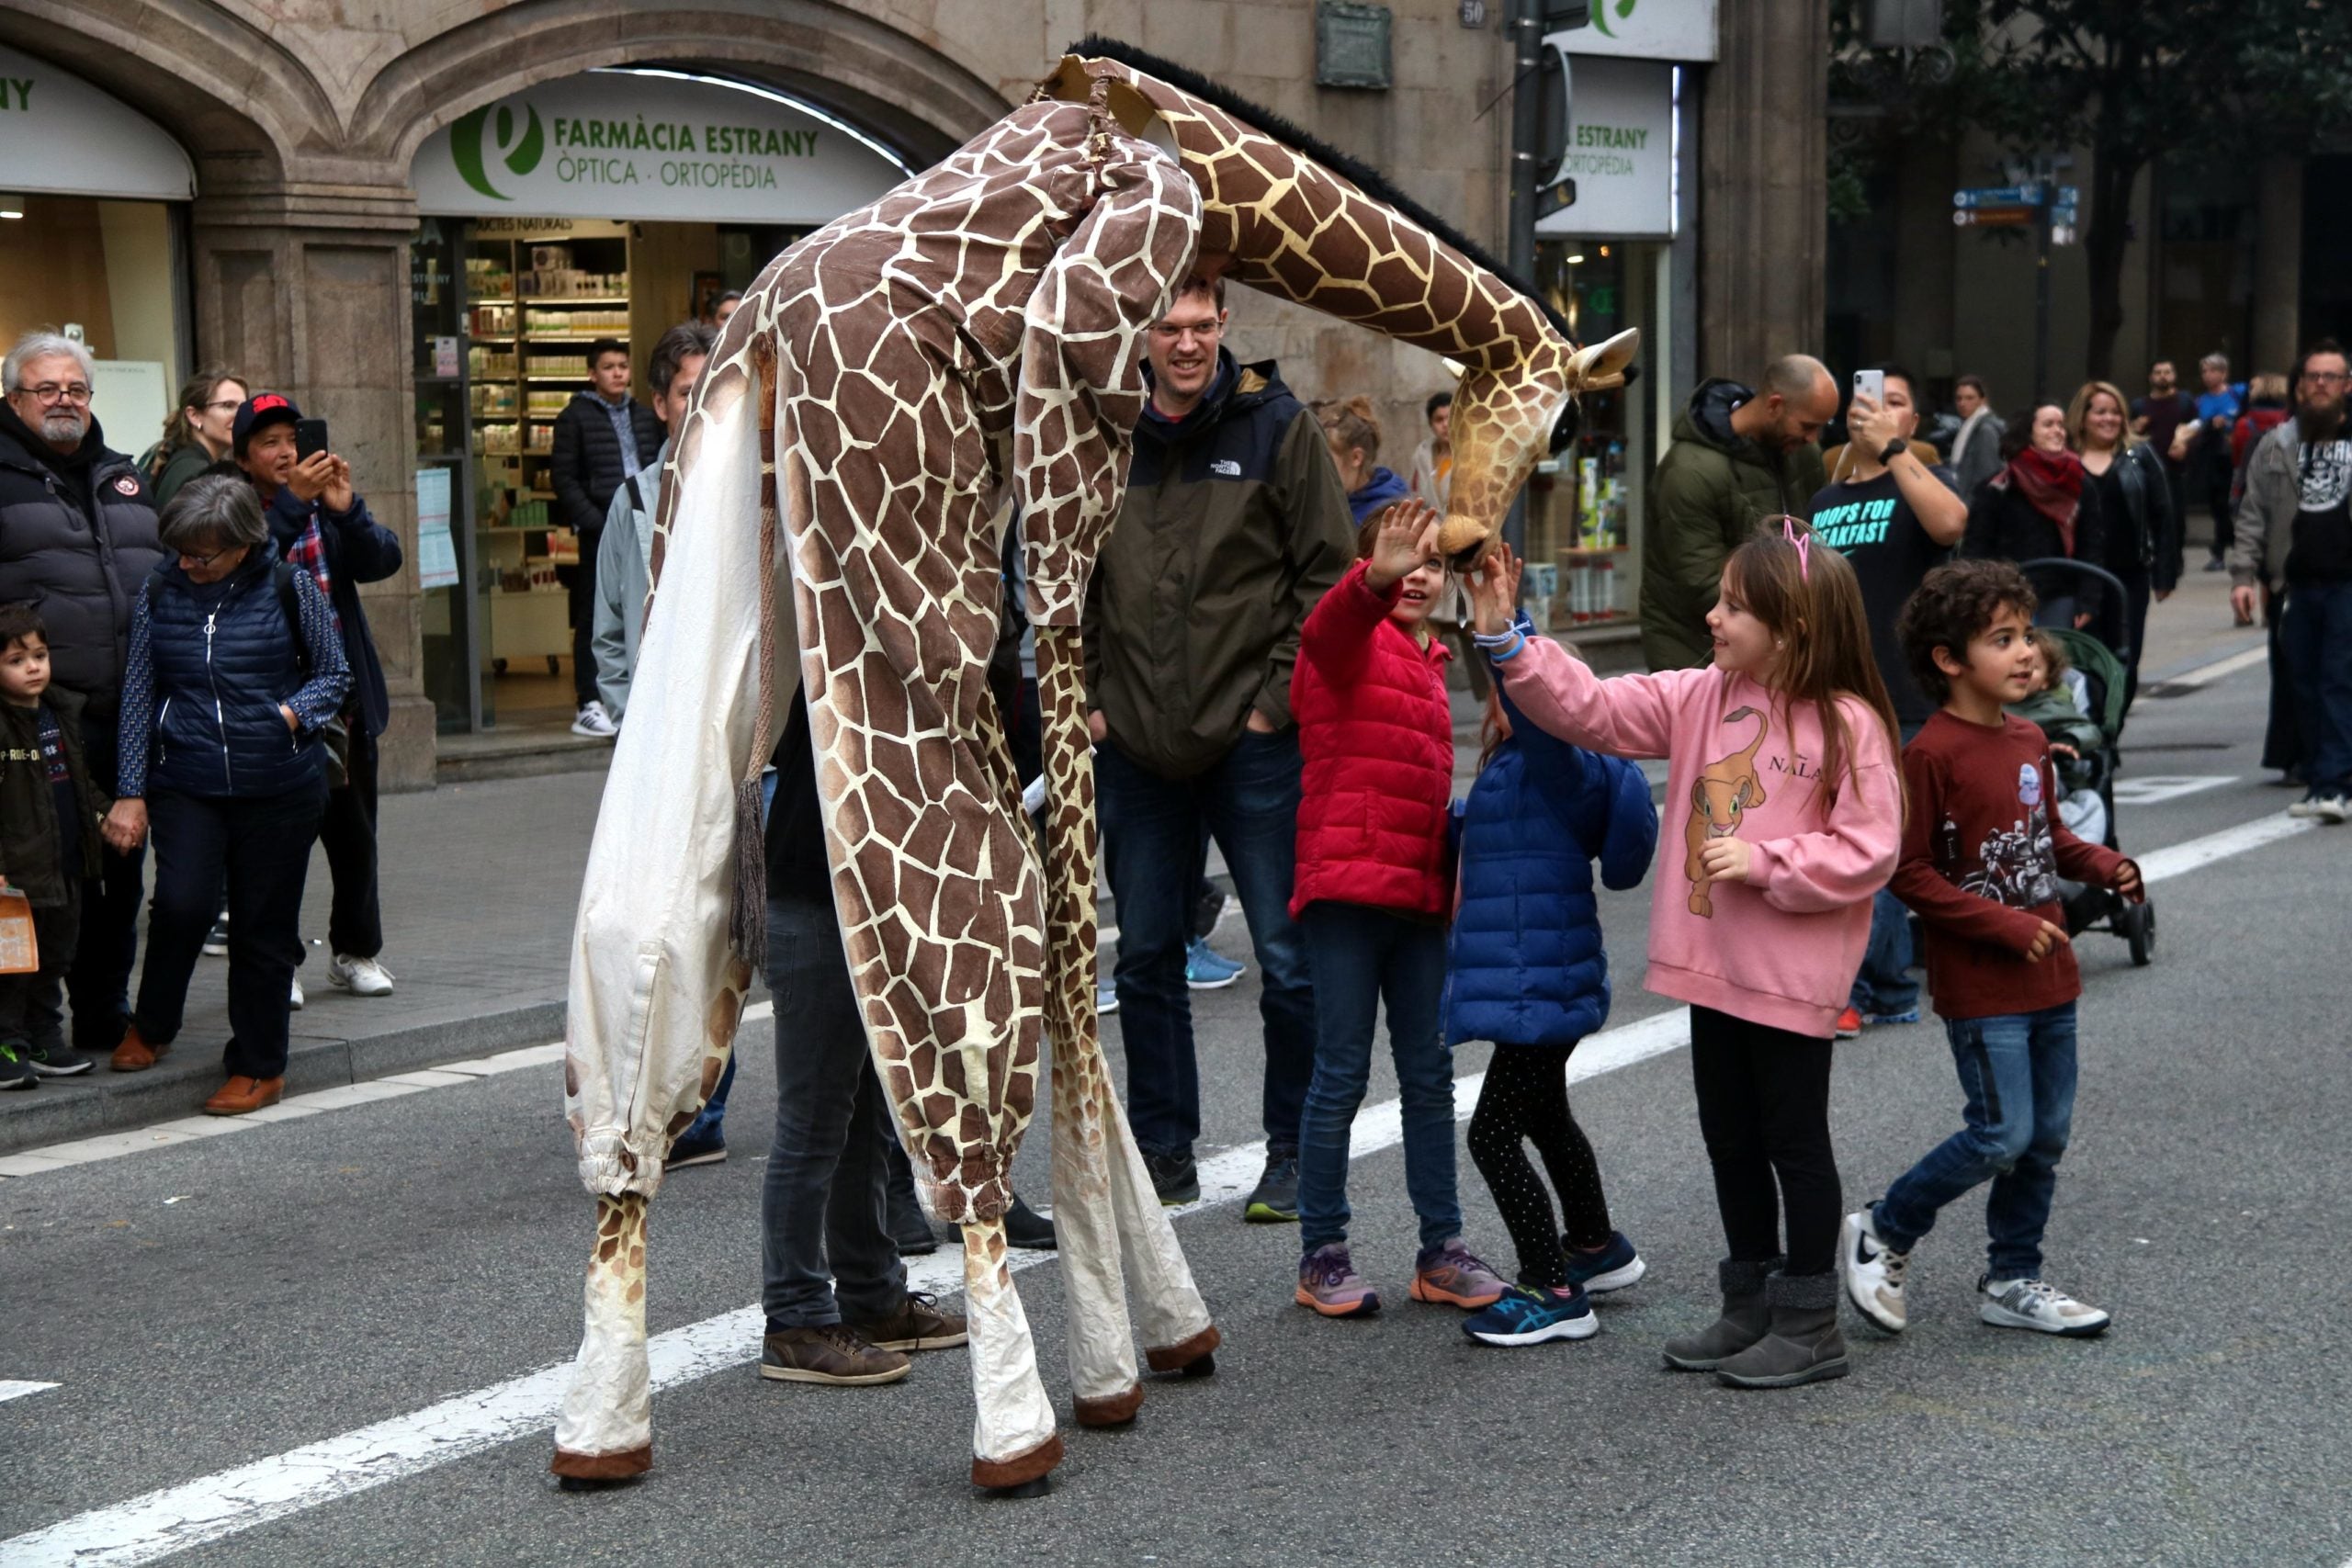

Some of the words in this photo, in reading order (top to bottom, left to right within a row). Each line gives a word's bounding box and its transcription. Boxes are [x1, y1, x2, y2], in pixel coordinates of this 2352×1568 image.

[1464, 1, 1484, 23] 50
[555, 113, 695, 152] FARMÀCIA
[706, 126, 818, 157] ESTRANY
[1577, 124, 1647, 150] ESTRANY
[557, 150, 639, 184] ÒPTICA
[661, 157, 777, 189] ORTOPÈDIA
[1812, 502, 1860, 530] HOOPS
[1860, 499, 1896, 522] FOR
